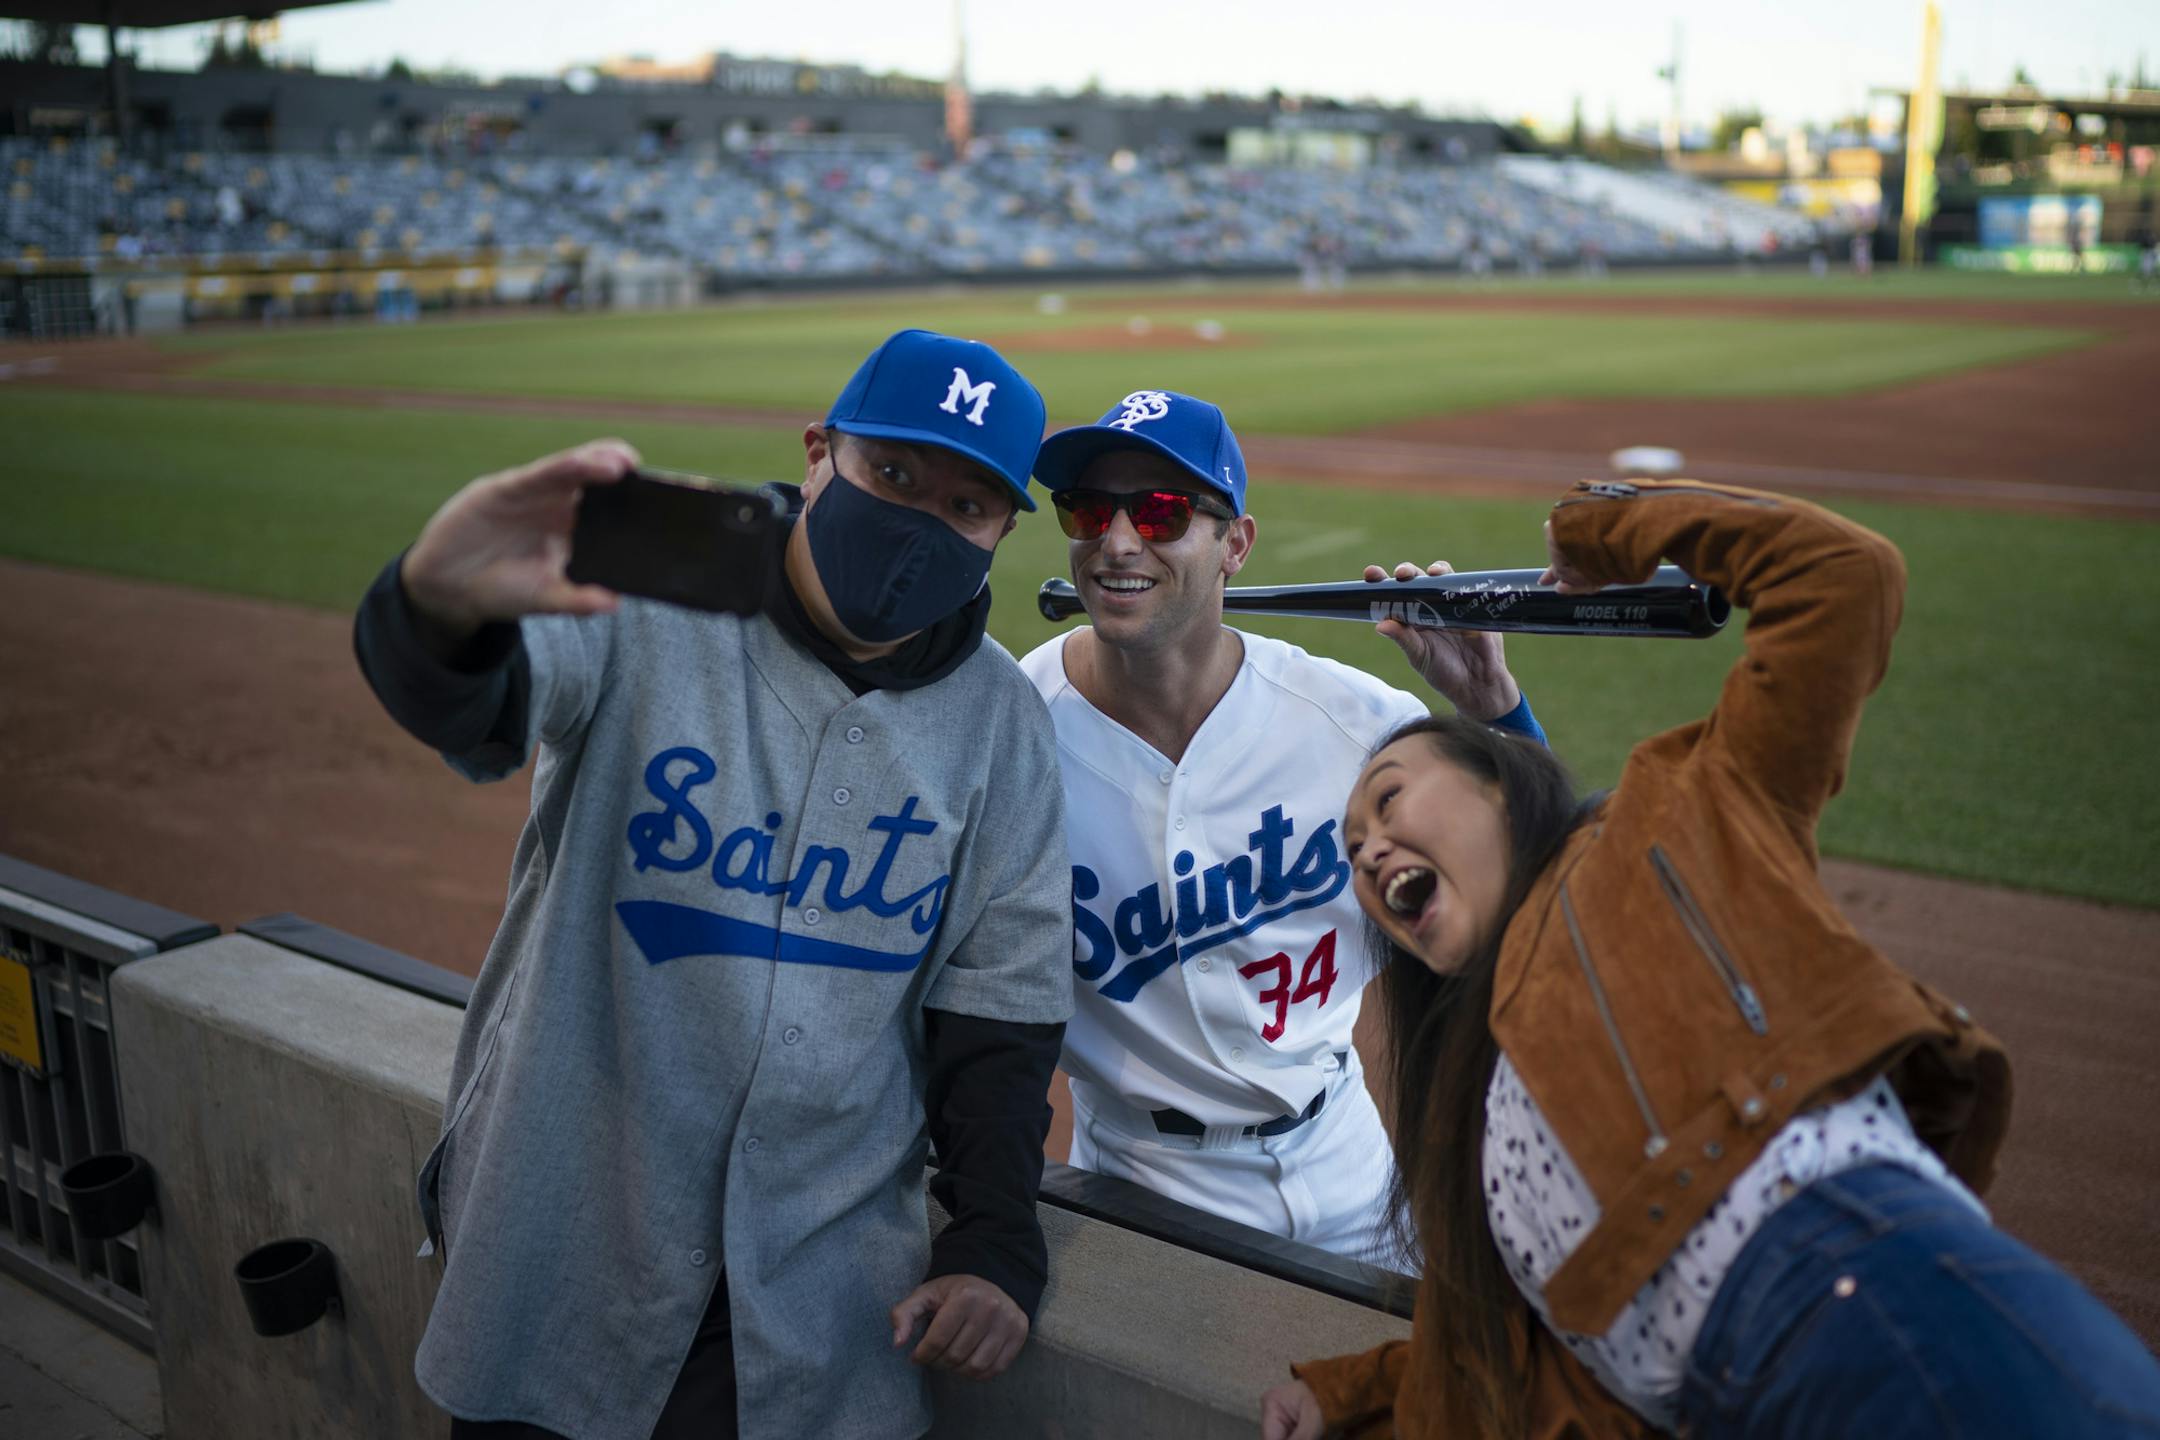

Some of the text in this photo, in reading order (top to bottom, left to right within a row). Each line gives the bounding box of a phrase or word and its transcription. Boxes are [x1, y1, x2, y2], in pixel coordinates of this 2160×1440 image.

[939, 367, 996, 426] M
[1573, 606, 1648, 620] MODEL 110
[627, 746, 951, 935] Saints
[1072, 804, 1342, 981] Saints
[1238, 928, 1339, 1043] 34
